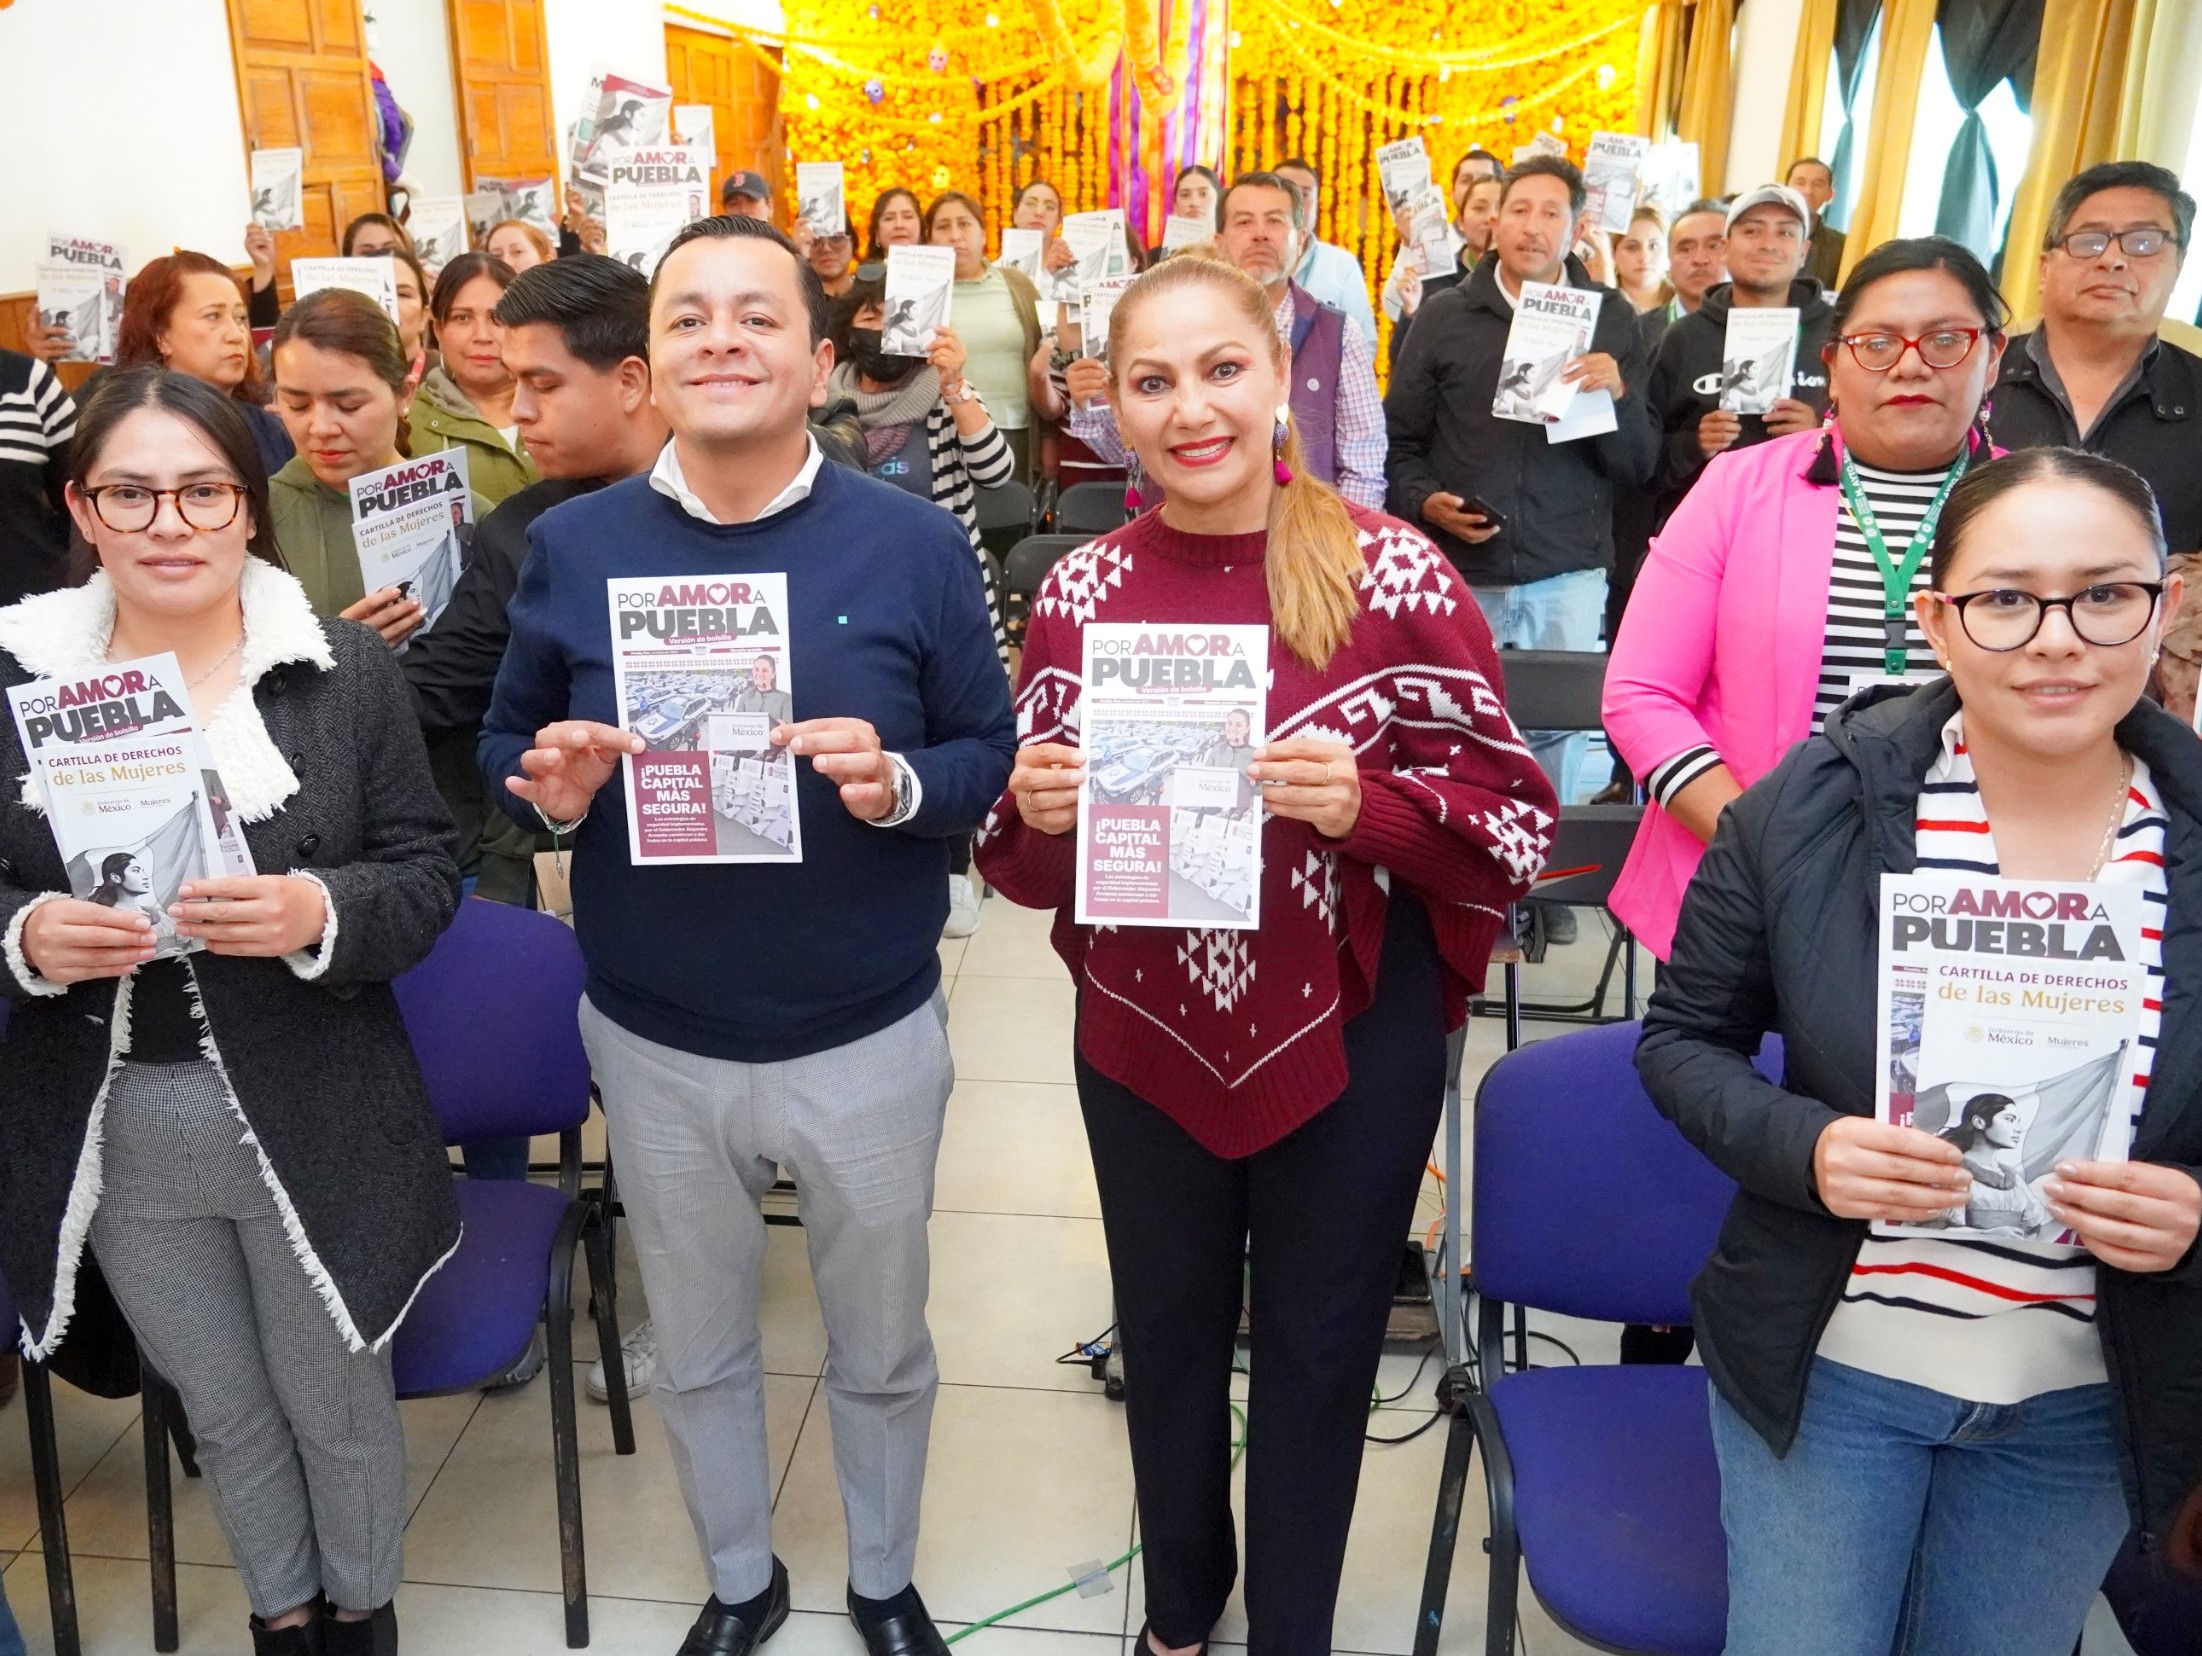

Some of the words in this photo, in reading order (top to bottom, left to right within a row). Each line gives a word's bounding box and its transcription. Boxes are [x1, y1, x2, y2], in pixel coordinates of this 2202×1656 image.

[612, 156, 632, 165] POR
[633, 152, 687, 165] AMOR
[1593, 143, 1642, 158] PUEBLA
[612, 166, 702, 184] PUEBLA
[70, 238, 113, 255] AMOR
[50, 245, 124, 270] PUEBLA
[1544, 289, 1586, 305] AMOR
[1522, 298, 1592, 322] PUEBLA
[356, 482, 384, 498] POR
[383, 459, 446, 490] AMOR
[445, 461, 454, 472] A
[358, 471, 464, 519] PUEBLA
[360, 519, 395, 537] CARTILLA
[396, 515, 405, 524] DE
[406, 502, 444, 520] DERECHOS
[362, 536, 378, 549] de
[380, 530, 397, 542] las
[399, 512, 445, 536] Mujeres
[617, 592, 656, 609] POR
[656, 582, 754, 608] AMOR
[752, 589, 766, 604] A
[618, 606, 780, 640] PUEBLA
[668, 636, 696, 646] Versión
[696, 636, 706, 644] de
[706, 634, 732, 642] bolsillo
[1092, 639, 1132, 655] POR
[1131, 633, 1232, 657] AMOR
[1230, 642, 1246, 656] A
[1092, 657, 1257, 689] PUEBLA
[19, 696, 58, 718] POR
[58, 670, 150, 709] AMOR
[148, 674, 162, 690] A
[1141, 686, 1169, 694] Versión
[1180, 684, 1207, 694] bolsillo
[24, 690, 186, 749] PUEBLA
[104, 730, 114, 738] de
[114, 725, 139, 737] bolsillo
[732, 727, 764, 736] México
[48, 754, 101, 768] CARTILLA
[104, 753, 119, 764] DE
[122, 746, 182, 761] DERECHOS
[53, 770, 75, 786] de
[80, 769, 106, 784] las
[110, 762, 186, 782] Mujeres
[640, 764, 702, 778] ¡PUEBLA
[640, 777, 704, 790] CAPITAL
[1198, 783, 1232, 793] México
[140, 798, 172, 807] Mujeres
[656, 787, 690, 802] MÁS
[98, 804, 132, 814] México
[642, 803, 706, 815] SEGURA!
[1096, 818, 1161, 832] ¡PUEBLA
[1094, 832, 1162, 846] CAPITAL
[1109, 844, 1146, 859] MÁS
[1093, 859, 1162, 873] SEGURA!
[1892, 892, 1948, 915] POR
[1946, 888, 2090, 921] AMOR
[2088, 902, 2110, 922] A
[1892, 914, 2126, 962] PUEBLA
[1940, 964, 2015, 984] CARTILLA
[2020, 972, 2039, 984] DE
[2044, 974, 2129, 991] DERECHOS
[1938, 981, 1968, 1001] de
[1976, 984, 2012, 1006] las
[2021, 988, 2125, 1015] Mujeres
[1988, 1033, 2034, 1046] México
[2048, 1036, 2089, 1047] Mujeres
